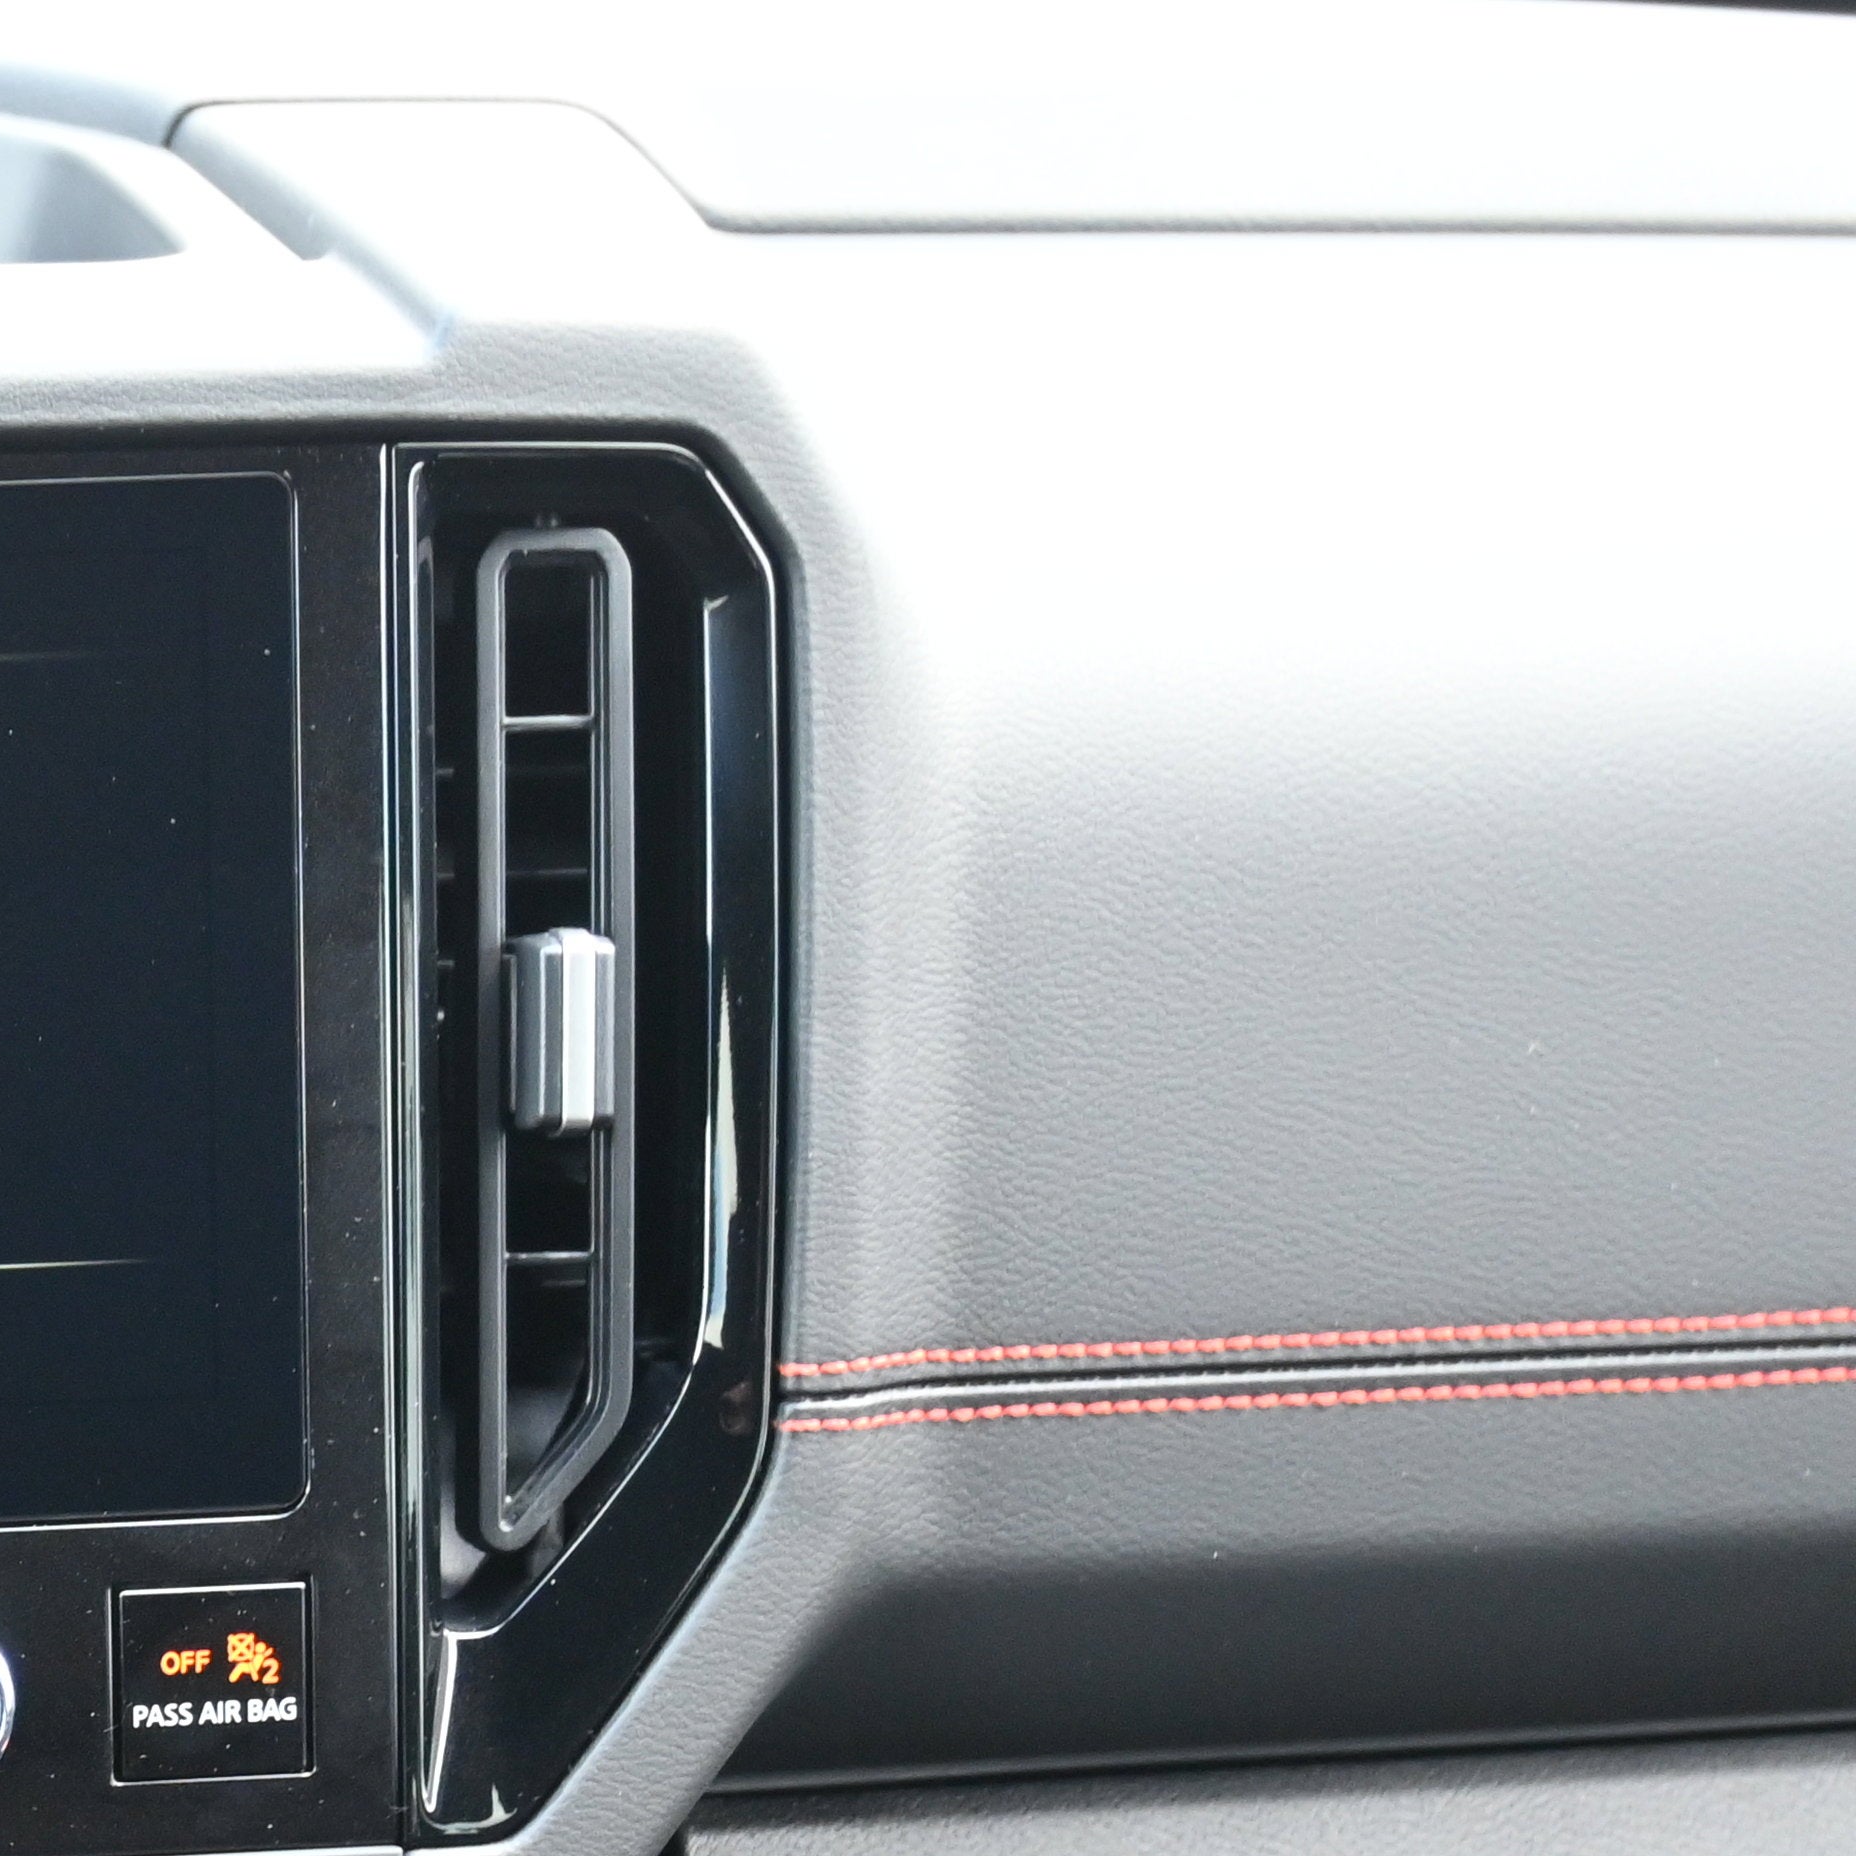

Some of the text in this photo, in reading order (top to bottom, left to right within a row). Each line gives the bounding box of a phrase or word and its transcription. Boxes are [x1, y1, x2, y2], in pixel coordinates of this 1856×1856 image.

[159, 1648, 212, 1676] OFF
[132, 1696, 298, 1729] PASS AIR BAG
